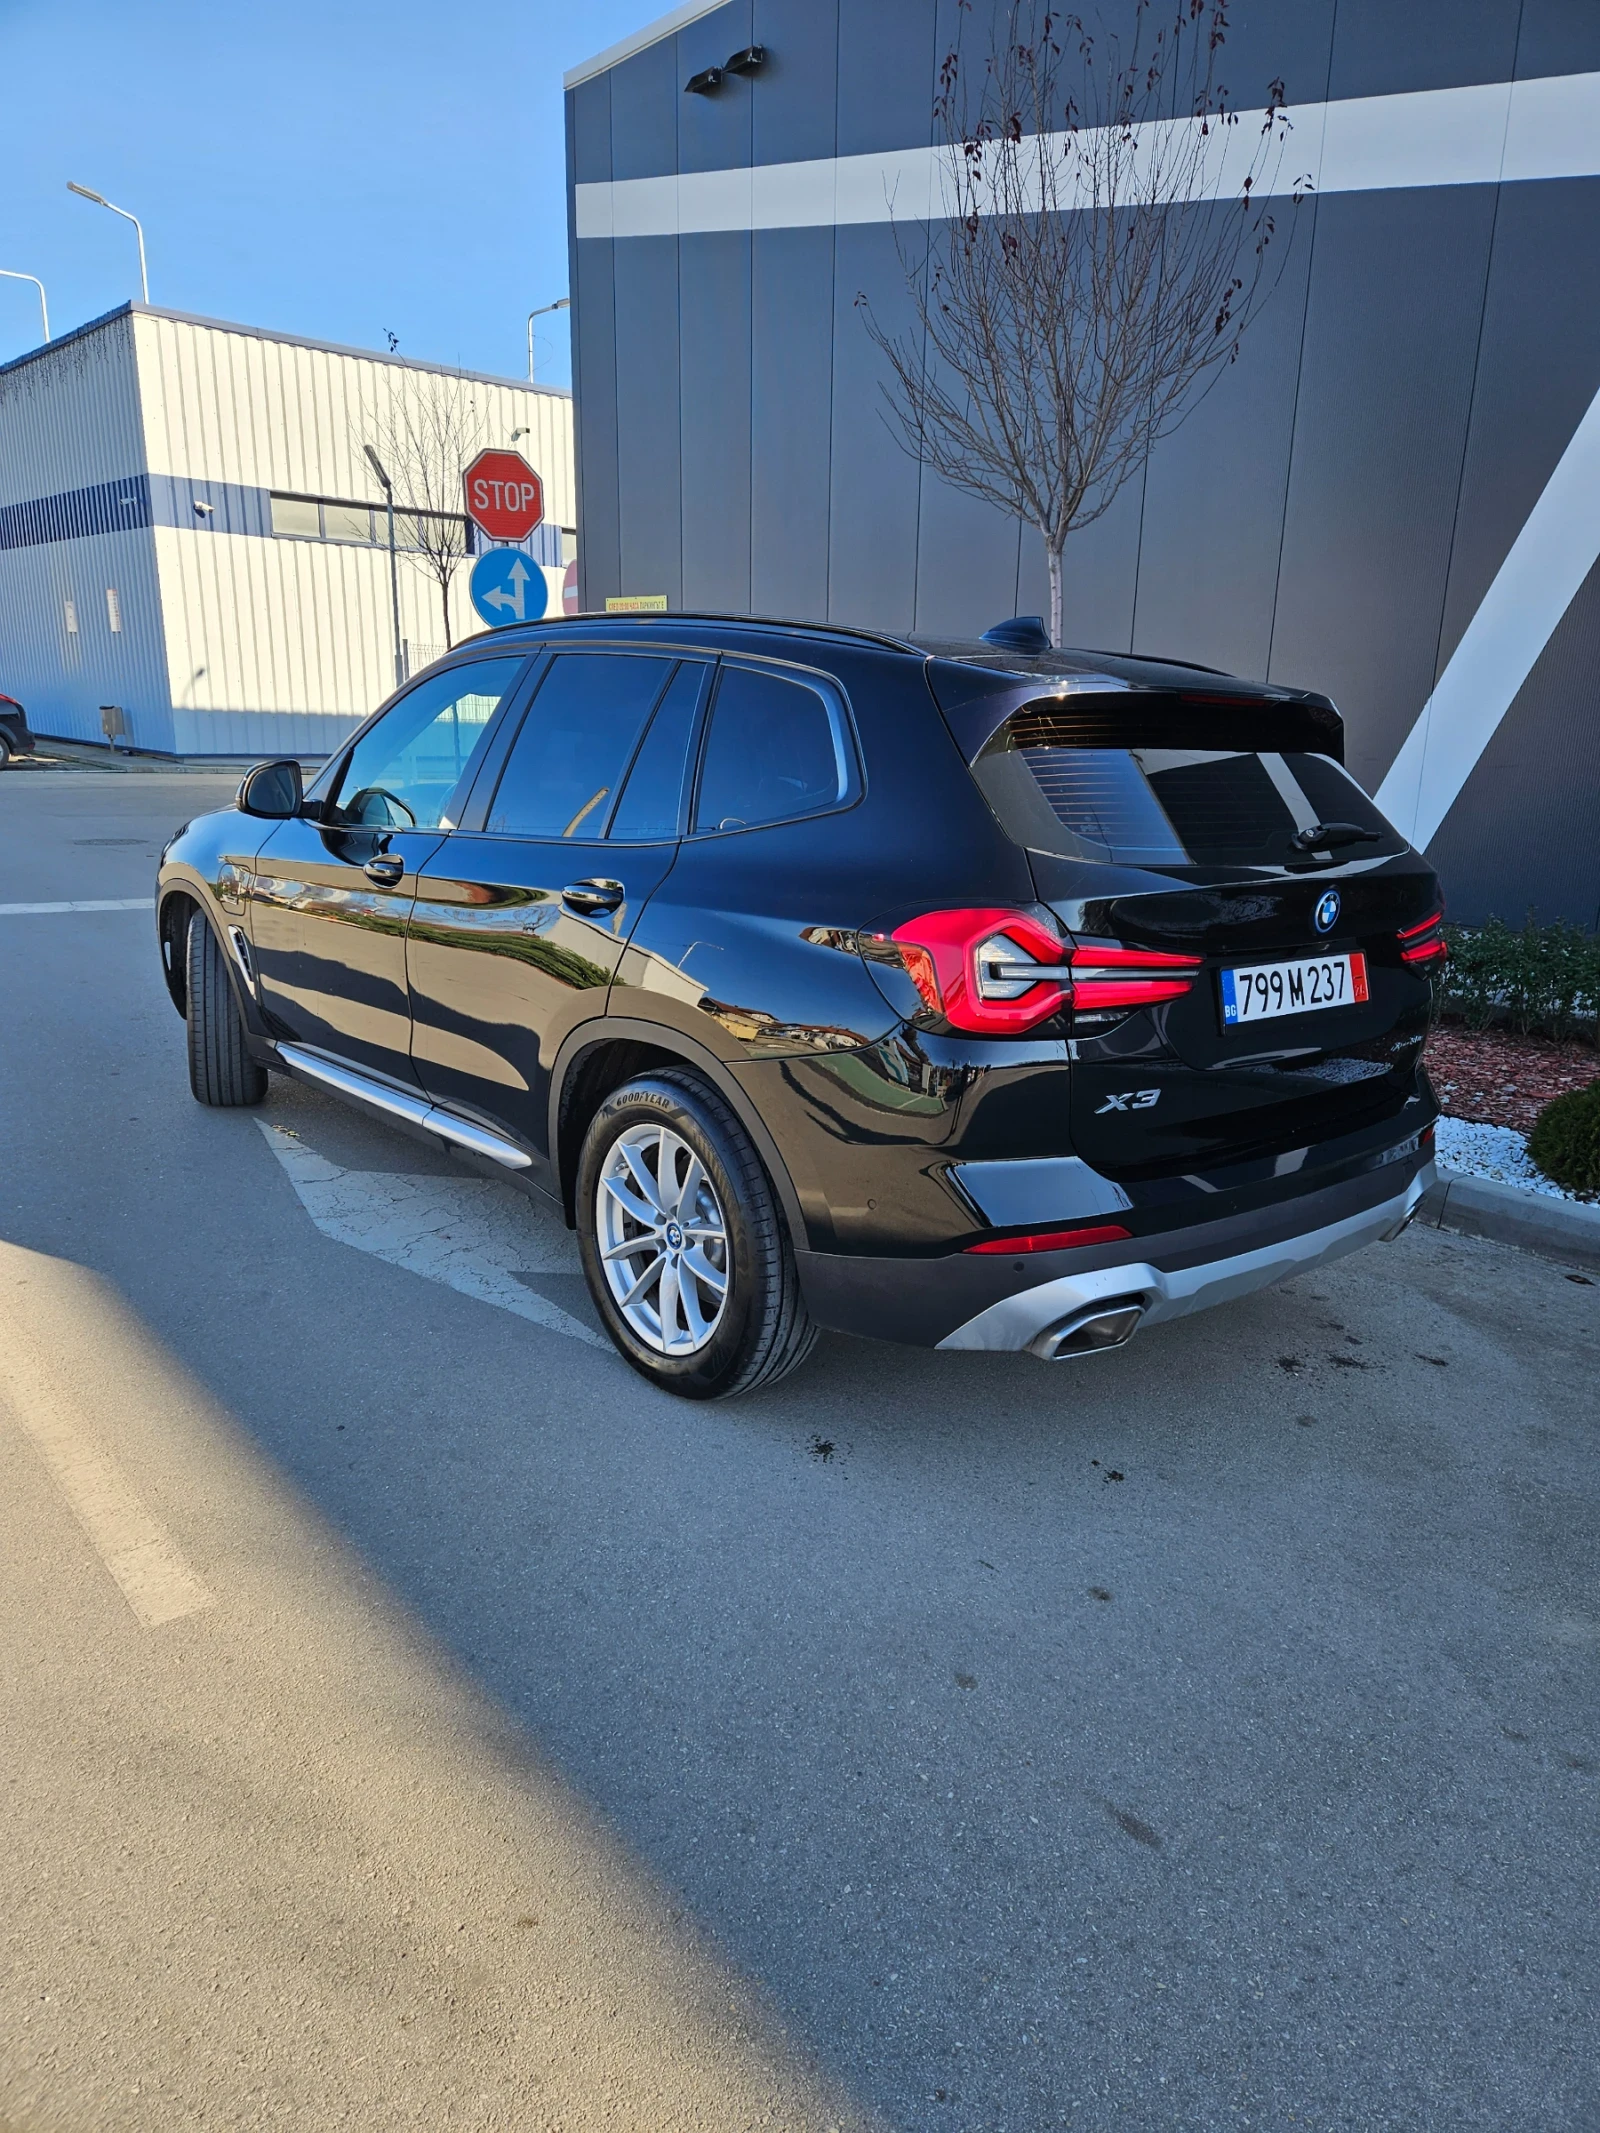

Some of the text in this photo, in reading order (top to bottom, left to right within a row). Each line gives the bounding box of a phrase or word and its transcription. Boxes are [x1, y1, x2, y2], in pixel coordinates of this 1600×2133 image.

[473, 479, 535, 512] STOP
[1225, 1004, 1237, 1018] BG
[616, 1091, 670, 1109] GOODYEAR
[1094, 1088, 1161, 1115] X3
